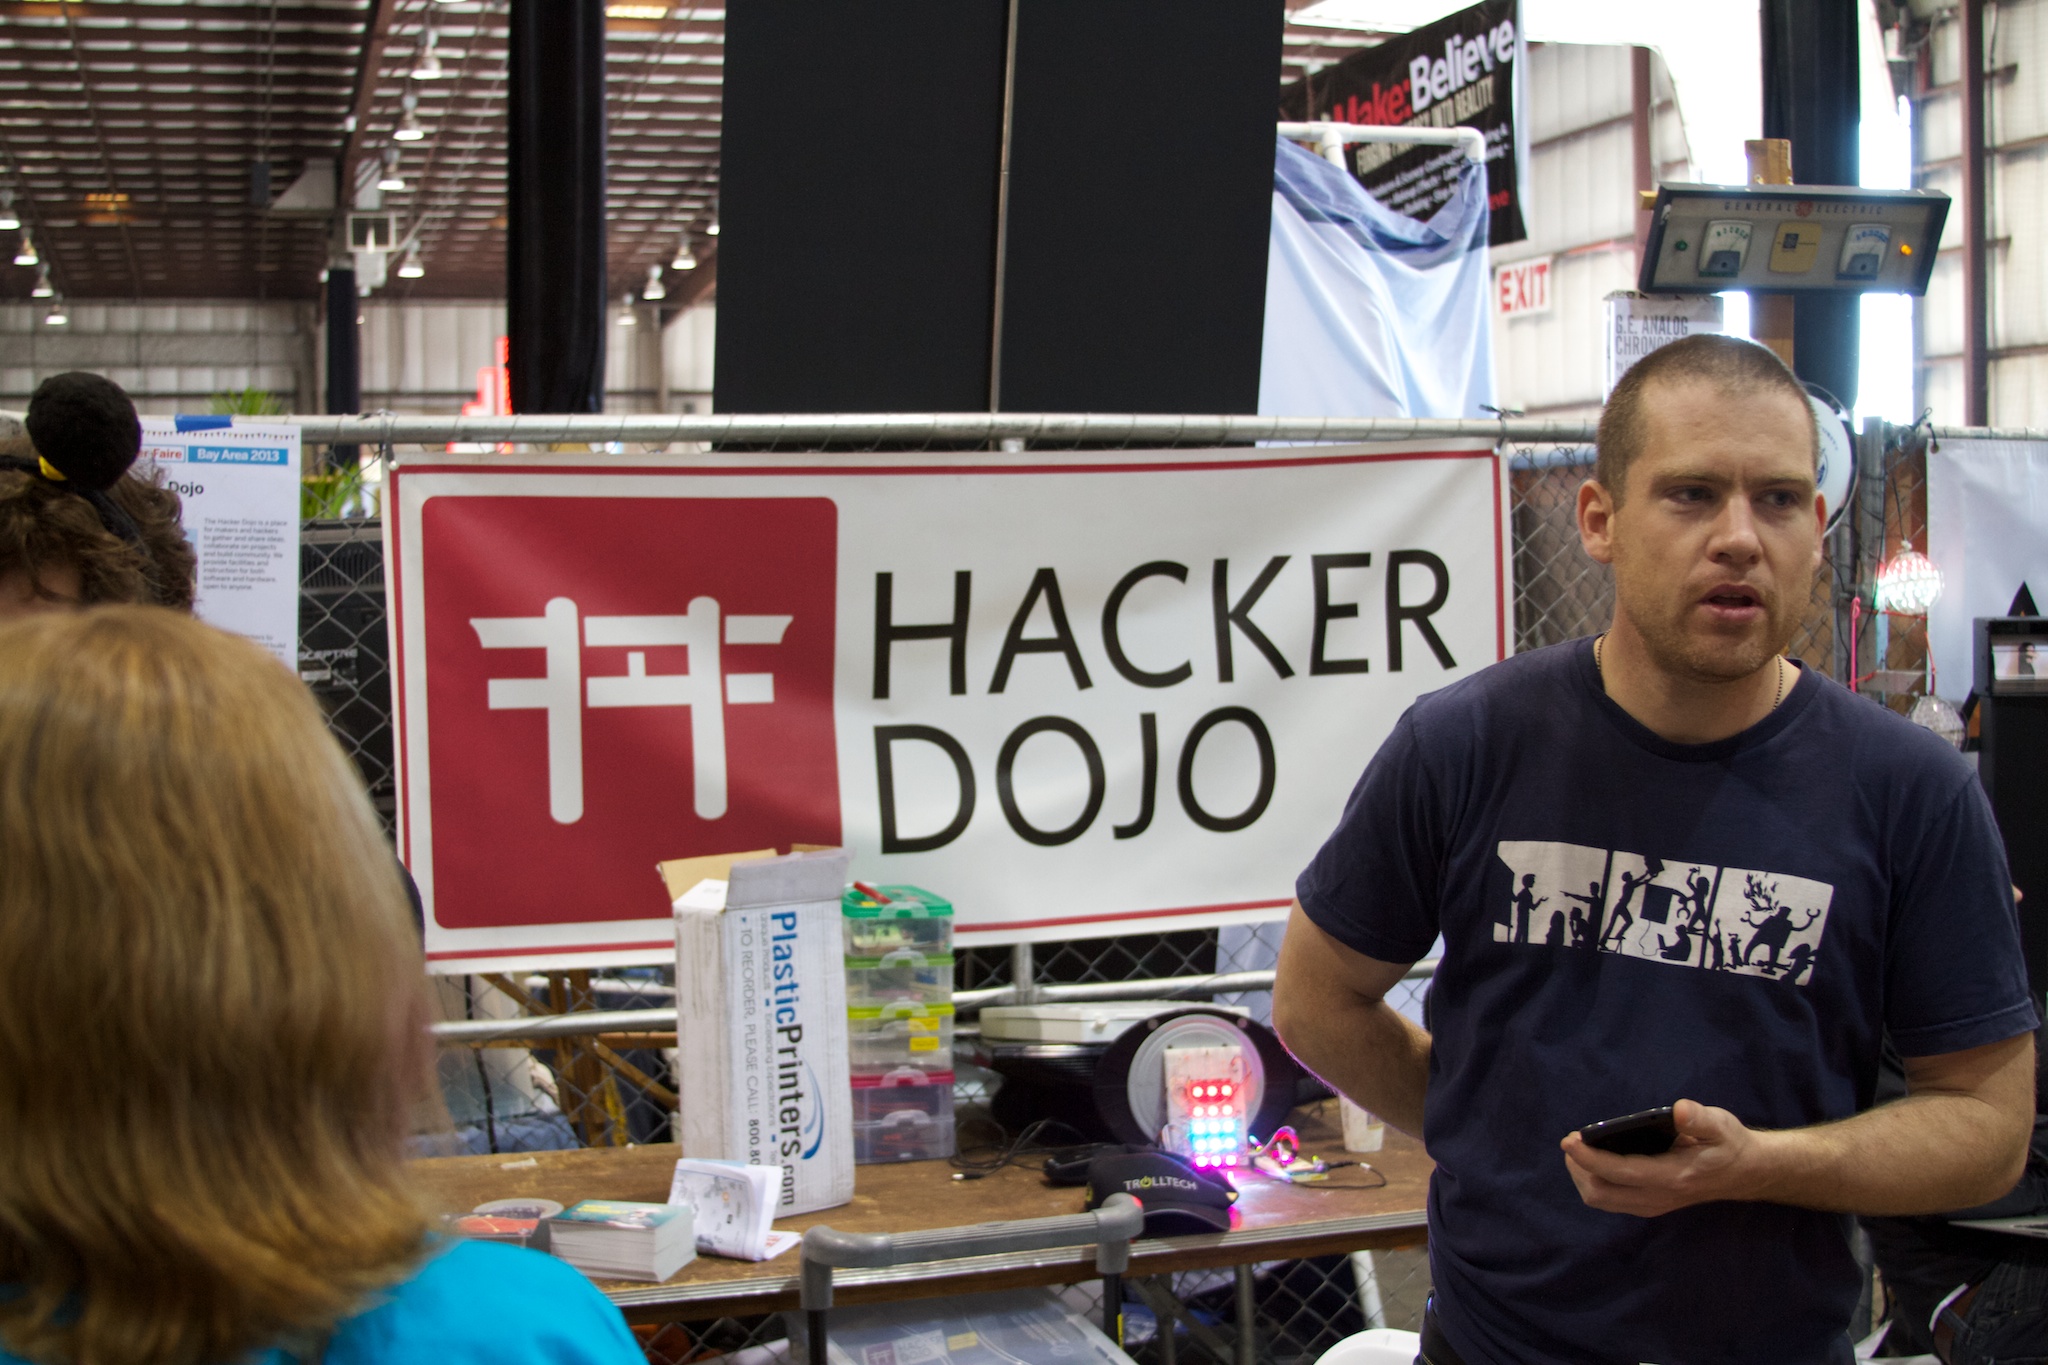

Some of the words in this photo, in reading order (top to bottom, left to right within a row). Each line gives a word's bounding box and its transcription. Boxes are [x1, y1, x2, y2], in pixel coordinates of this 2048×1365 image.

[1409, 20, 1515, 113] Believe
[1724, 201, 1792, 212] GENERAL
[1817, 205, 1883, 215] ELECTRIC
[1500, 264, 1547, 313] EXIT
[1615, 315, 1638, 334] G.E.
[1641, 315, 1689, 335] ANALOG
[153, 448, 182, 459] Faire
[197, 448, 220, 462] Bay
[222, 450, 249, 461] Area
[250, 451, 280, 462] 2013
[168, 480, 204, 497] Dojo
[872, 549, 1458, 699] HACKER
[873, 706, 1276, 854] DOJO
[741, 928, 753, 946] TO
[744, 1023, 758, 1072] PLEASE
[770, 911, 804, 1205] PlasticPrinters.com
[1123, 1175, 1198, 1191] TROLLTECH
